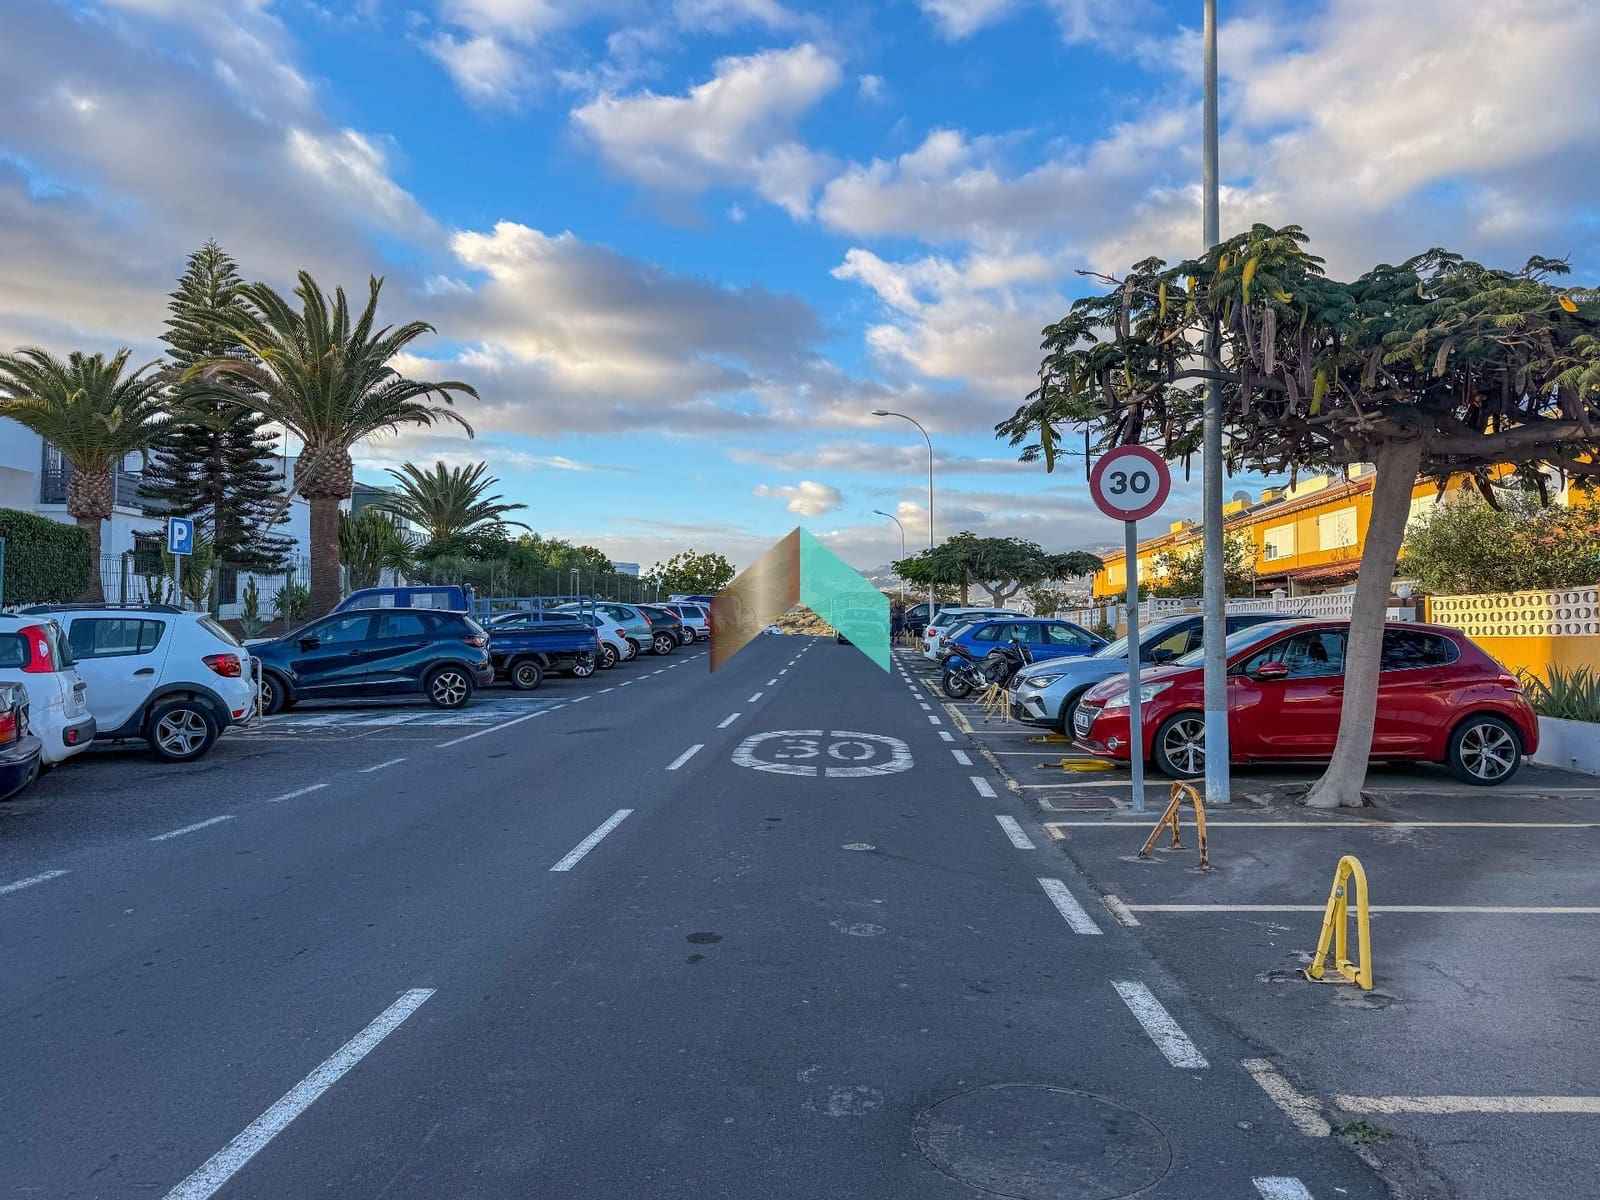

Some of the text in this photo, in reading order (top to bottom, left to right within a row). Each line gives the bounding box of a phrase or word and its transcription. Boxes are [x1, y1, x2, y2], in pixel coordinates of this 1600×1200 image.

[1109, 471, 1151, 495] 30
[173, 521, 188, 549] P
[775, 739, 876, 760] 30
